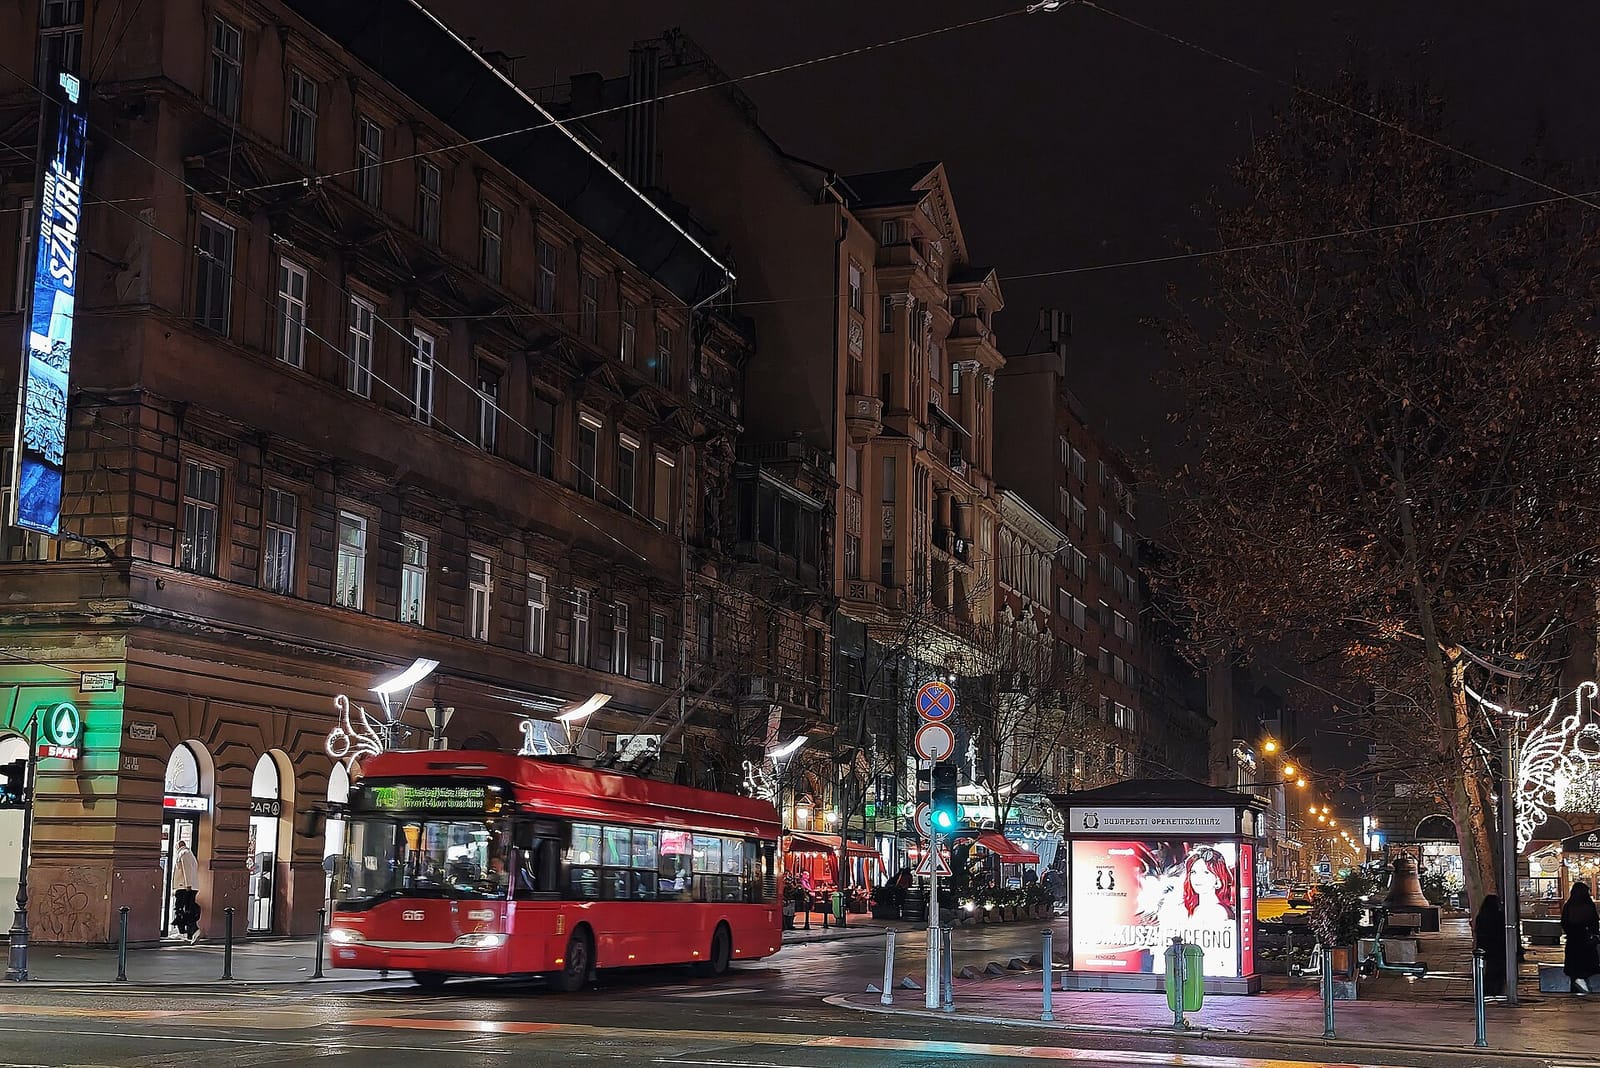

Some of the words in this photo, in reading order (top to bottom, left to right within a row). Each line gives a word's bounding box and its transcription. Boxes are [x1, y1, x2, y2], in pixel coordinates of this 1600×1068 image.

[42, 171, 56, 217] ORTON
[40, 215, 53, 244] JOE
[48, 746, 78, 758] SPAR
[250, 801, 271, 813] PAR
